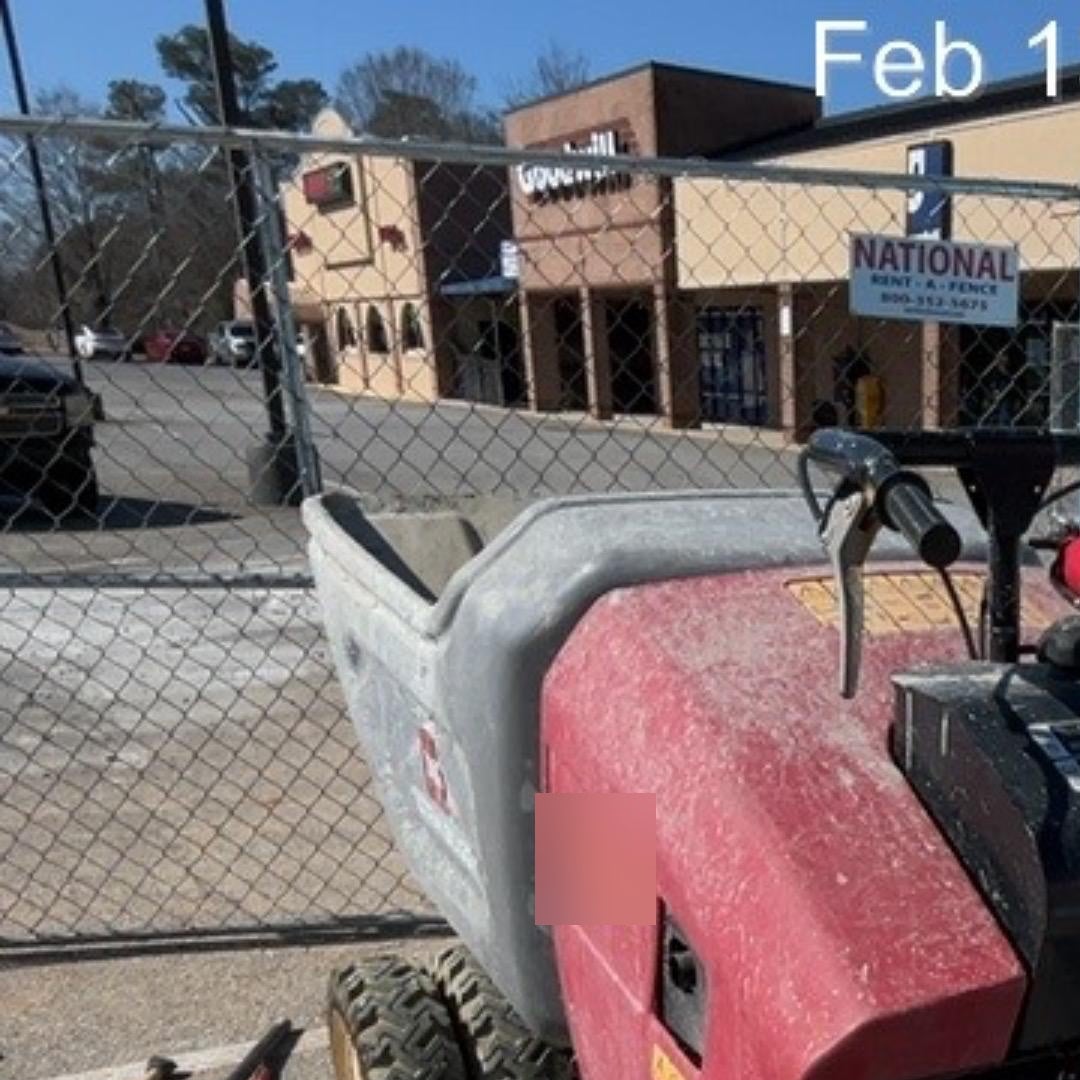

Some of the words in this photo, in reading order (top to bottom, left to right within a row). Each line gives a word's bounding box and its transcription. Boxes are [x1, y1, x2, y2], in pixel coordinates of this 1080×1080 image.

[855, 237, 1015, 282] NATIONAL
[871, 273, 912, 288] RENT
[948, 280, 998, 296] FENCE
